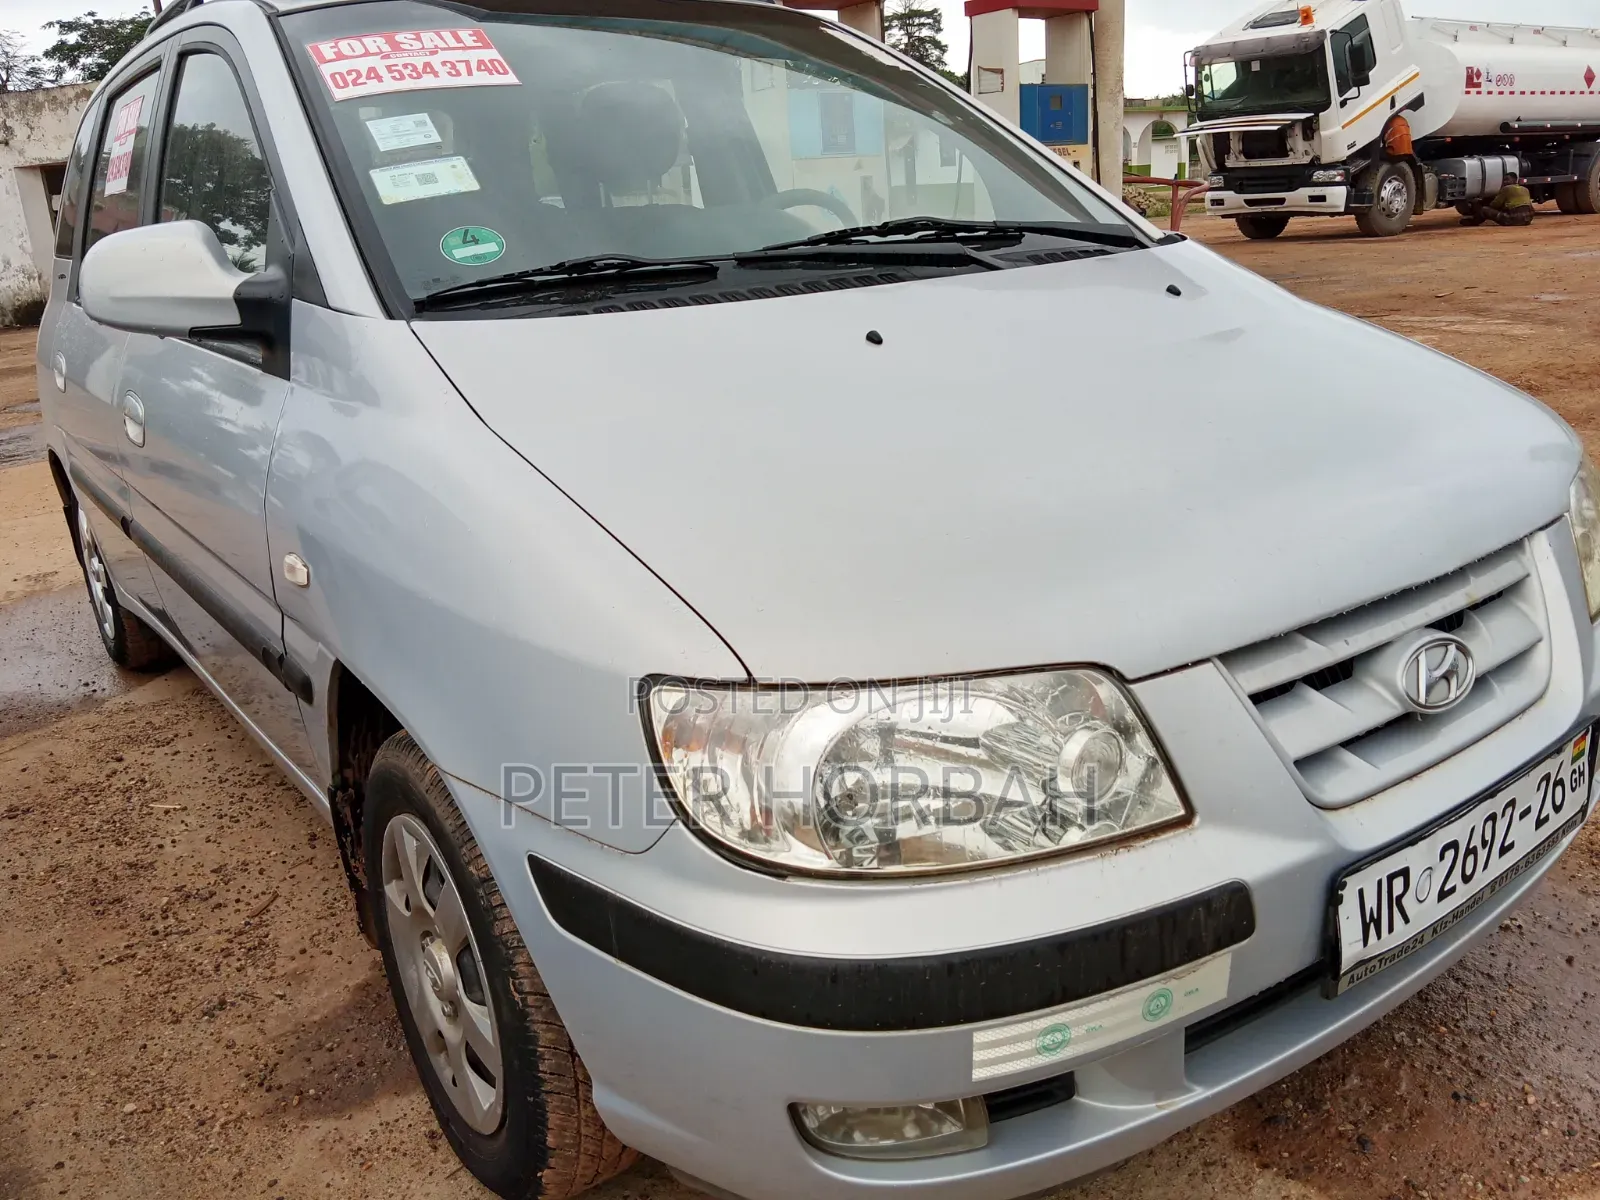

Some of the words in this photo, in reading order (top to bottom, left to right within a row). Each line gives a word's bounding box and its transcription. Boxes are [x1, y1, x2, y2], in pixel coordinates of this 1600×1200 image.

[318, 36, 393, 60] FOR
[394, 30, 483, 51] SALE
[389, 51, 430, 59] CONTACT
[329, 66, 384, 90] 024
[384, 60, 440, 82] 534
[440, 58, 510, 77] 3740
[462, 229, 479, 244] 4
[1570, 761, 1585, 793] GH
[1357, 865, 1411, 949] WR
[1436, 760, 1566, 904] 2692-26
[1431, 891, 1485, 938] Kfz-Handel
